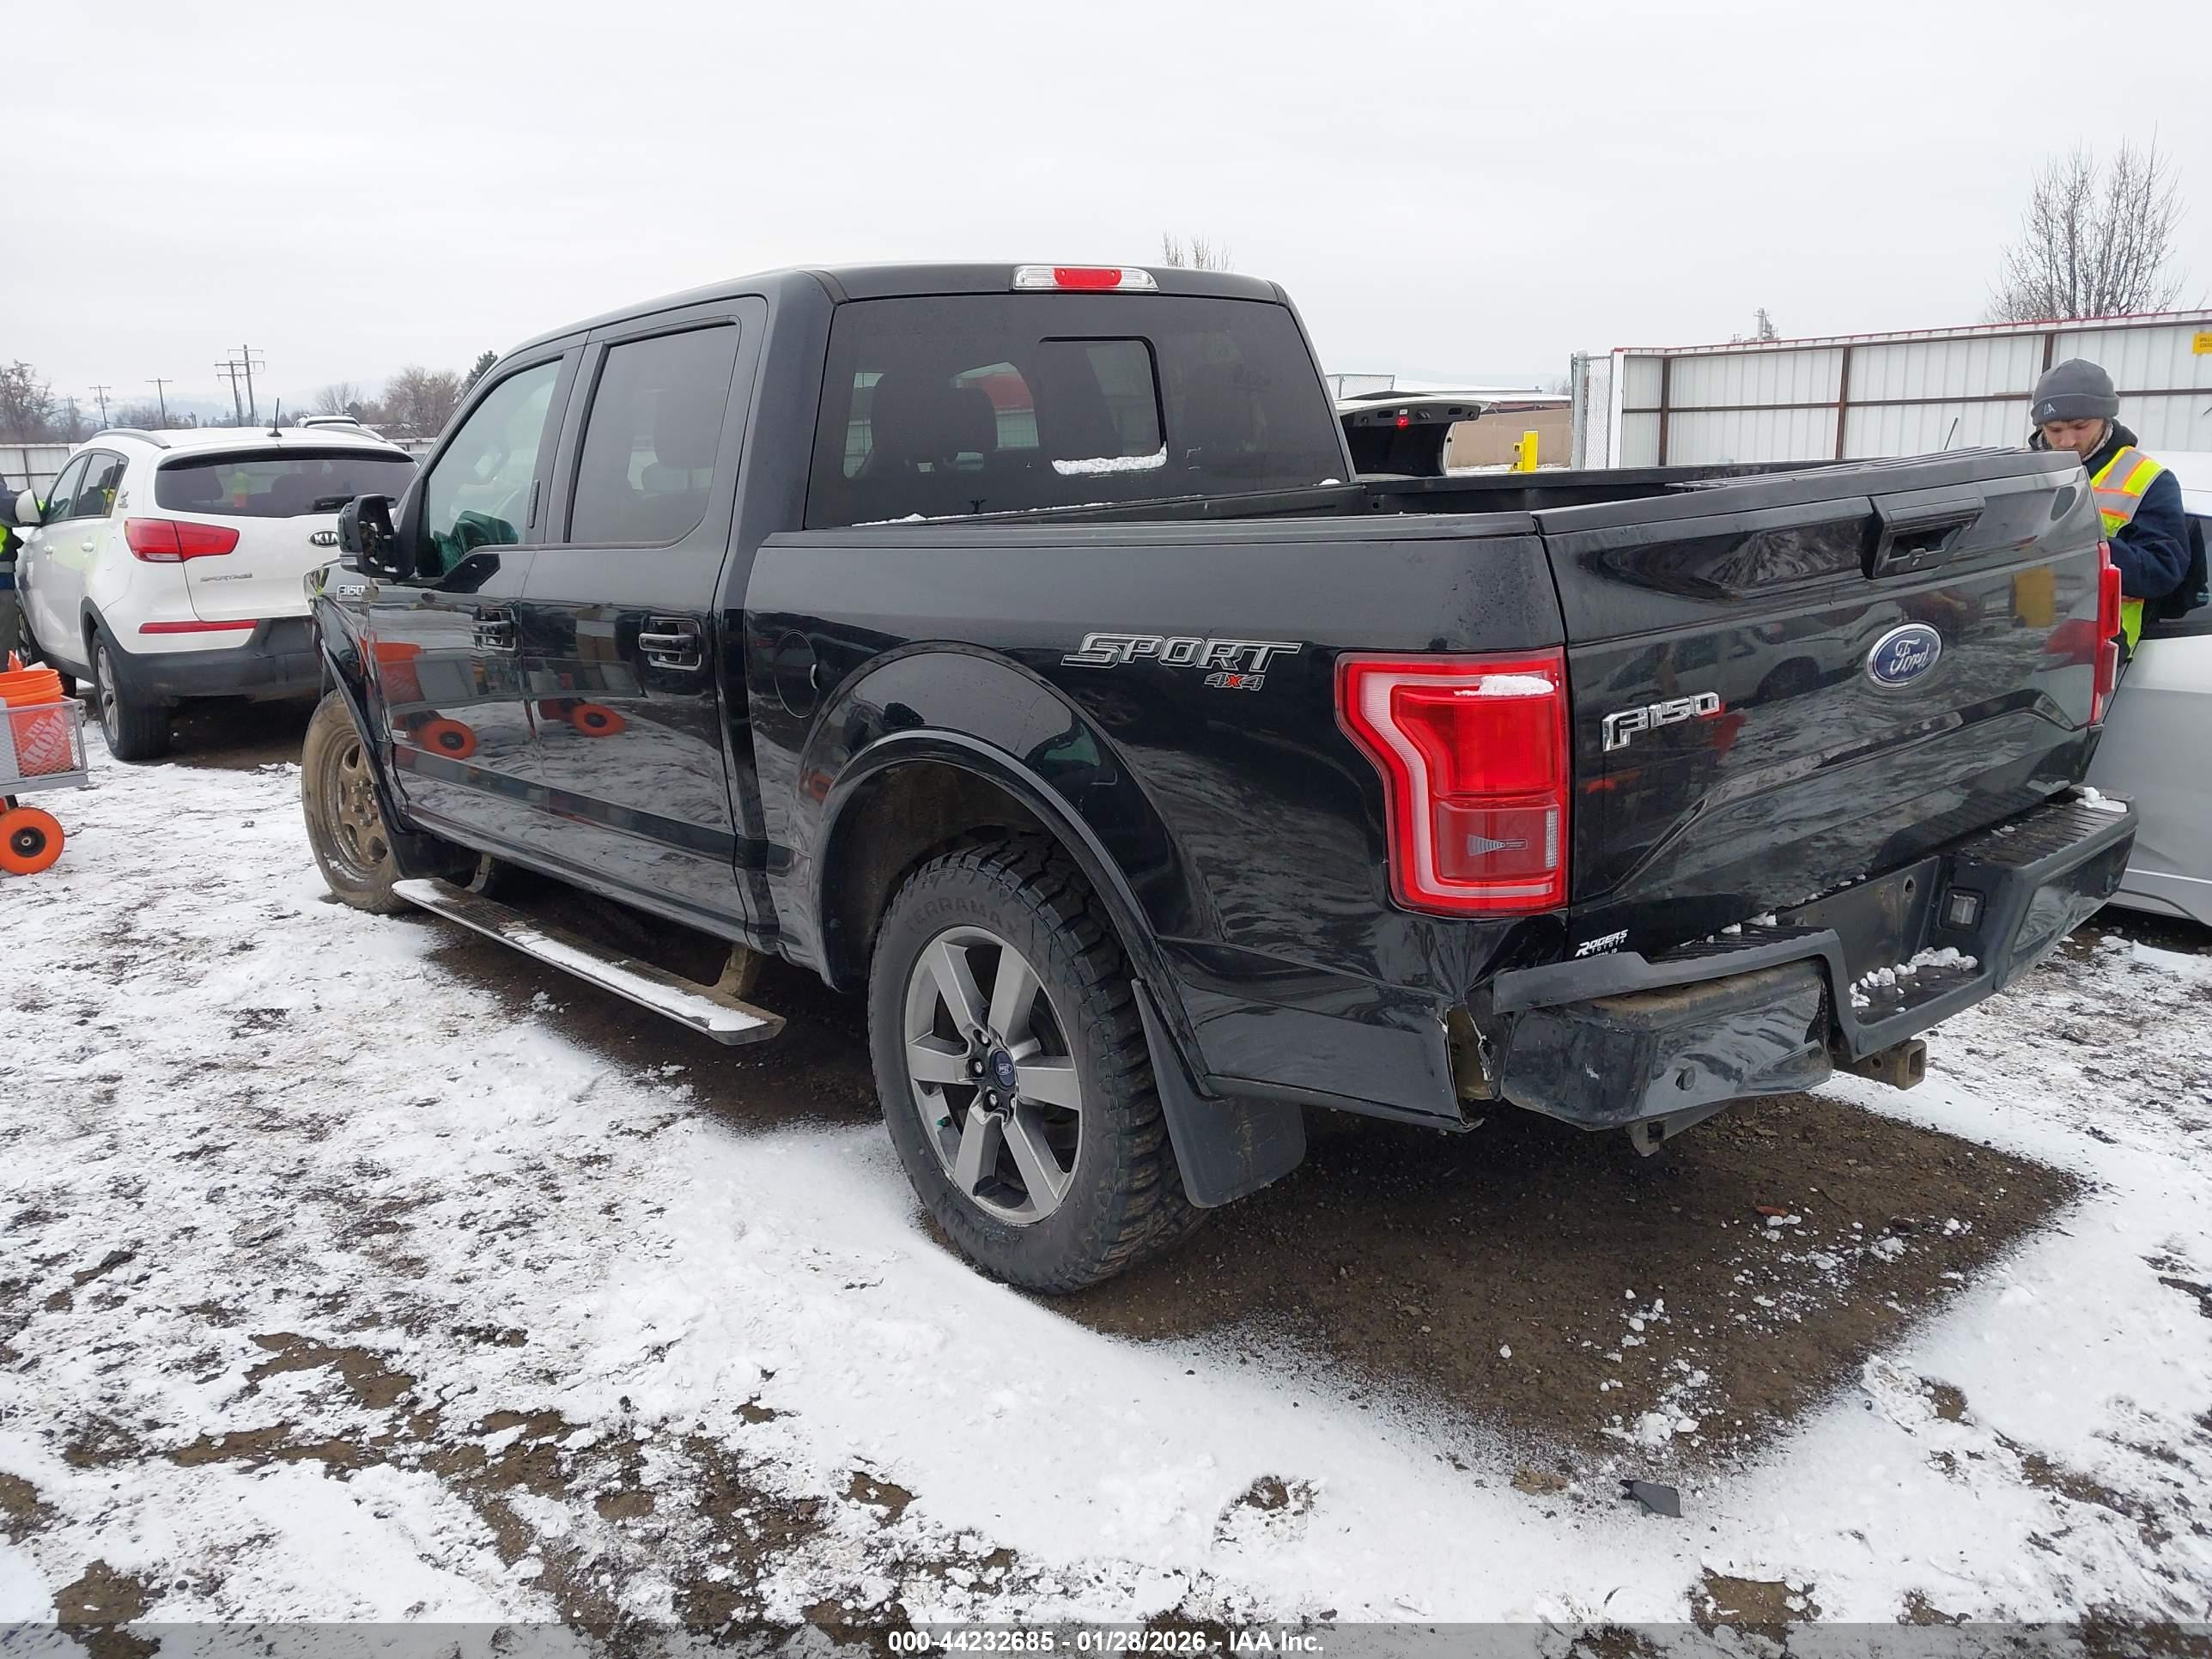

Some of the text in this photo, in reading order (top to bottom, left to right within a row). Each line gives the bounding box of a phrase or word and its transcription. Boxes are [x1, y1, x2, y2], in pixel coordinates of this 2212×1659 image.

[1060, 632, 1304, 673] SPORT
[1890, 638, 1930, 675] Ford
[1575, 929, 1629, 957] ROGERS
[1592, 938, 1625, 953] TOYOTA
